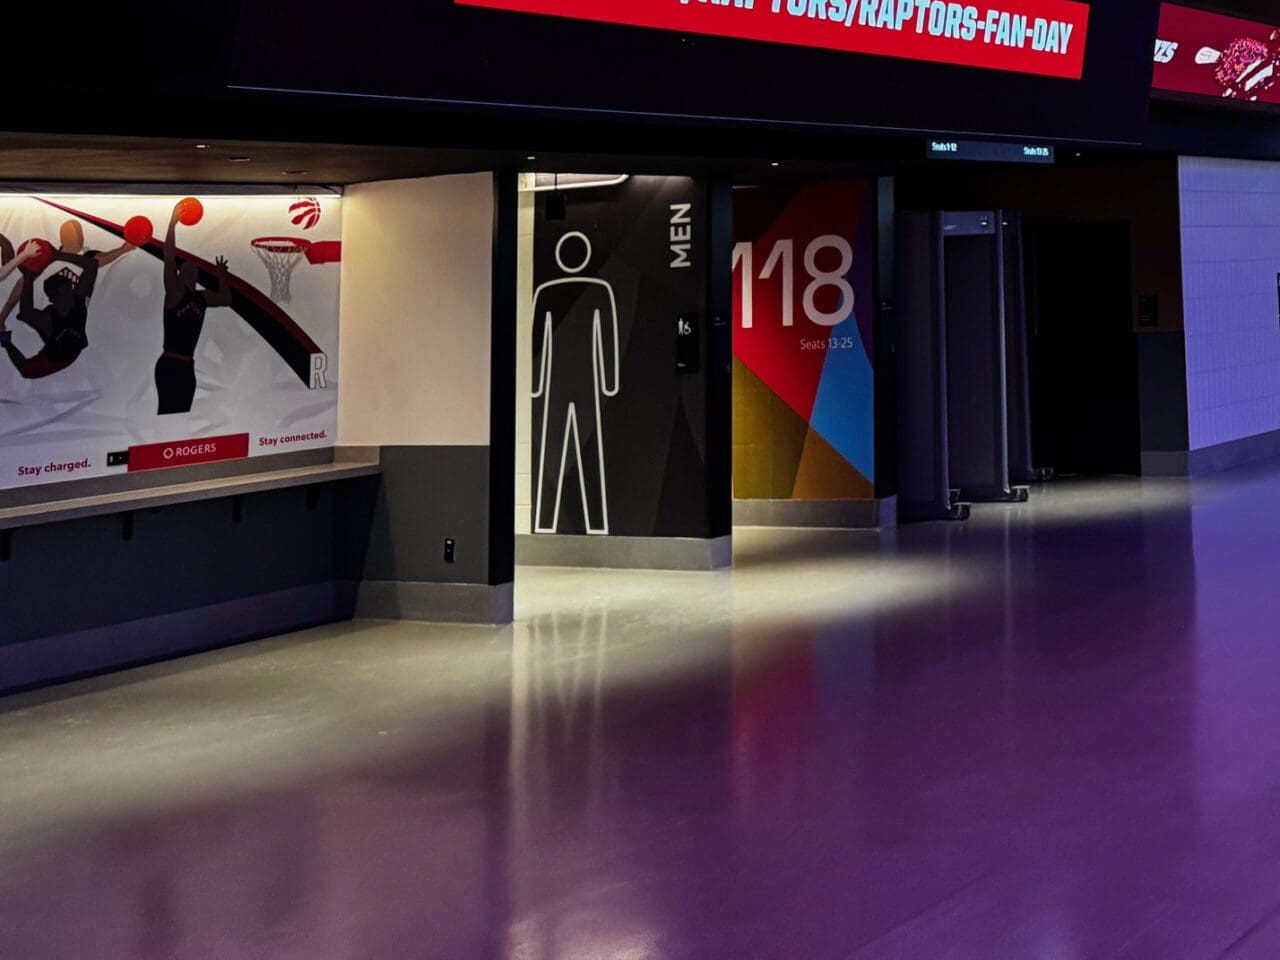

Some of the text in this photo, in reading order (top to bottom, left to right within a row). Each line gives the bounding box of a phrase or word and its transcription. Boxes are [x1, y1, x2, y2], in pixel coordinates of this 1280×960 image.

[670, 203, 692, 268] MEN
[732, 234, 855, 329] 118
[800, 337, 853, 350] Seats 13-25
[258, 429, 328, 448] Stay connected.
[175, 442, 217, 457] ROGERS
[17, 458, 92, 477] Stay charged.
